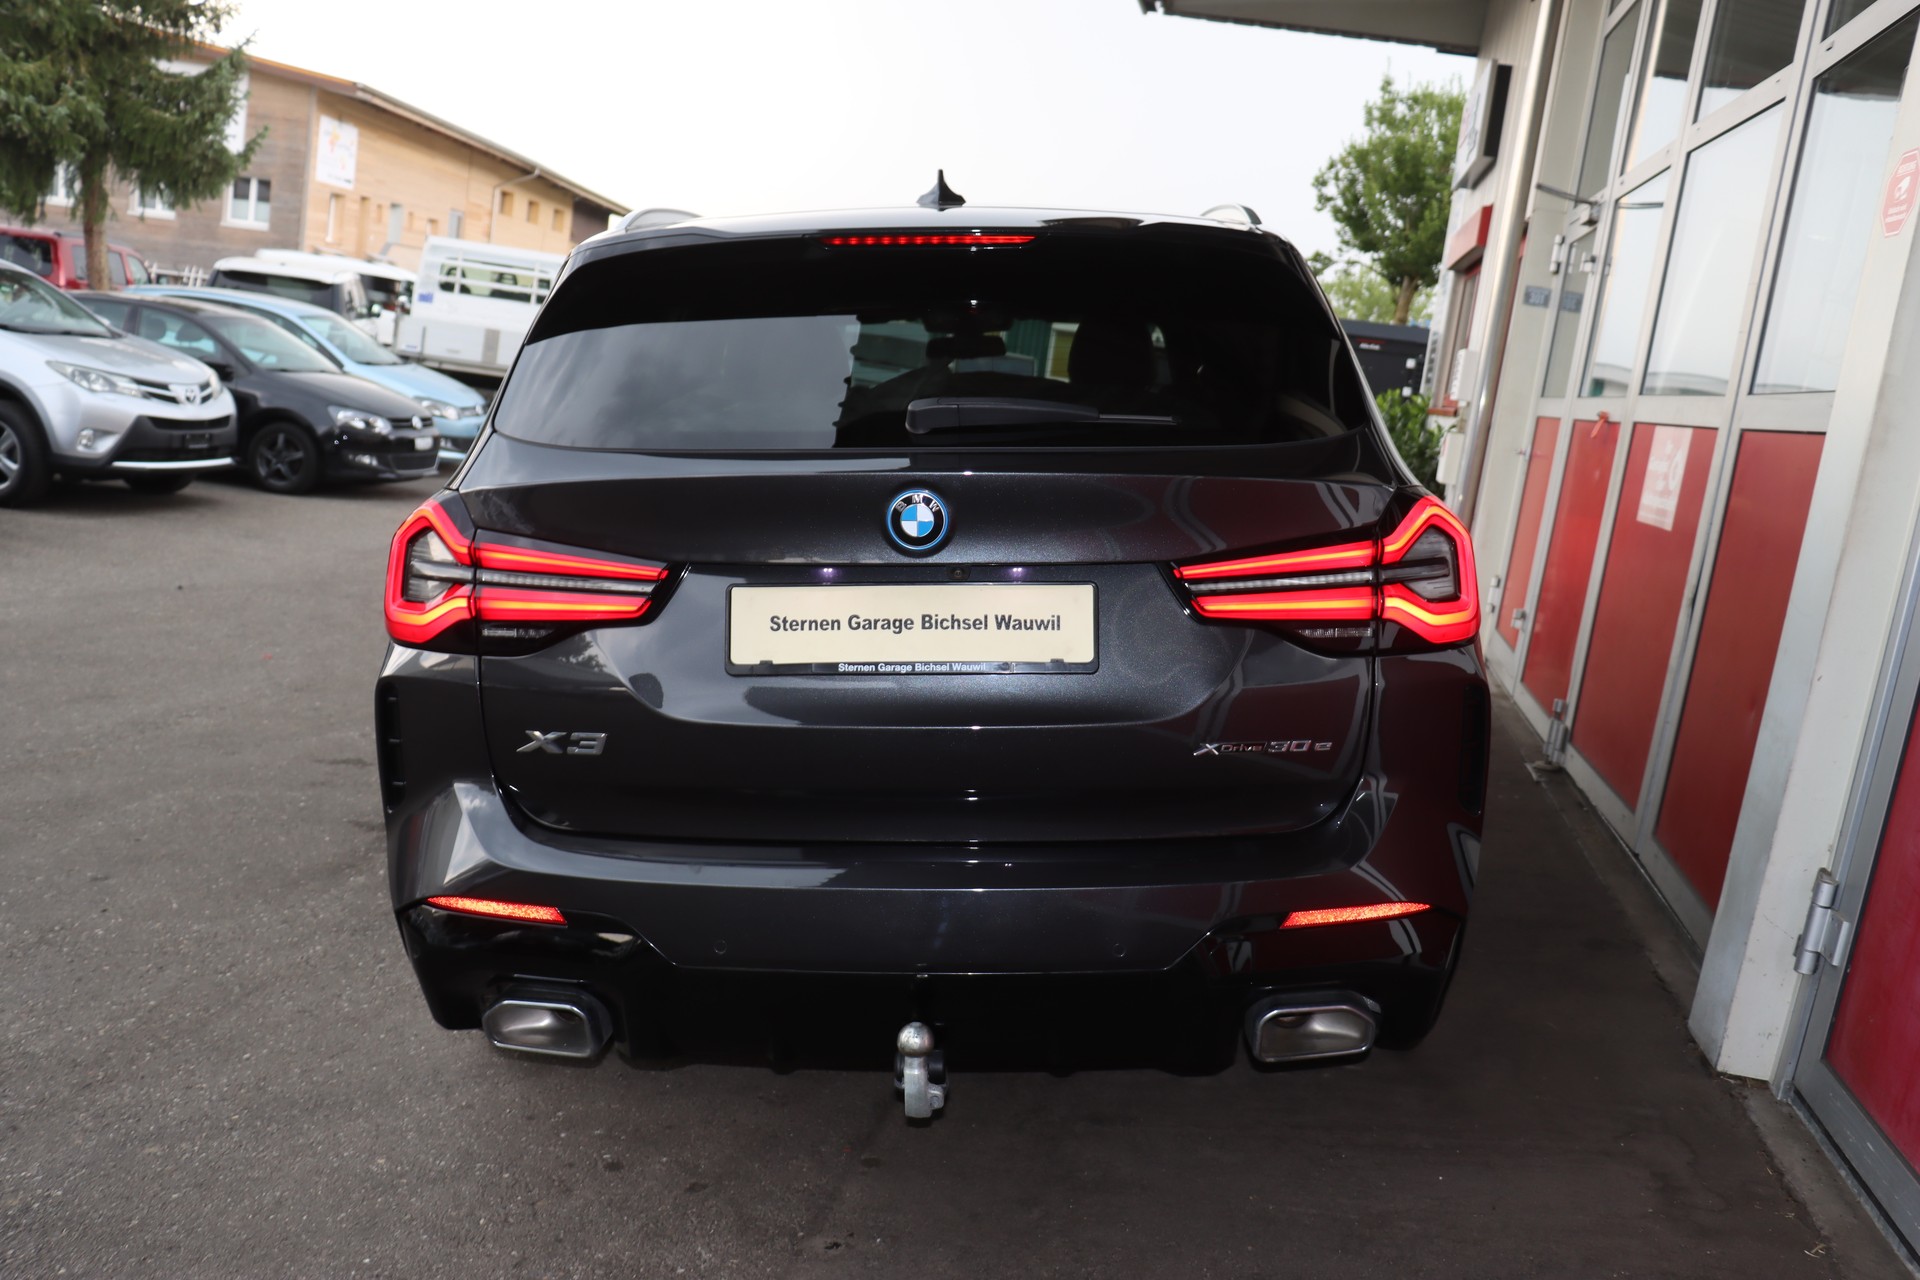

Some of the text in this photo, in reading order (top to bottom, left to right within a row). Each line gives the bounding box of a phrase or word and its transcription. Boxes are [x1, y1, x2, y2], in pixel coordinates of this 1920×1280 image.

[895, 493, 940, 512] BMW
[769, 614, 1061, 634] Sternen Garage Bichsel Wauwil
[838, 662, 986, 673] Sternen Garage Bichsel Wauwil
[516, 730, 607, 755] X3
